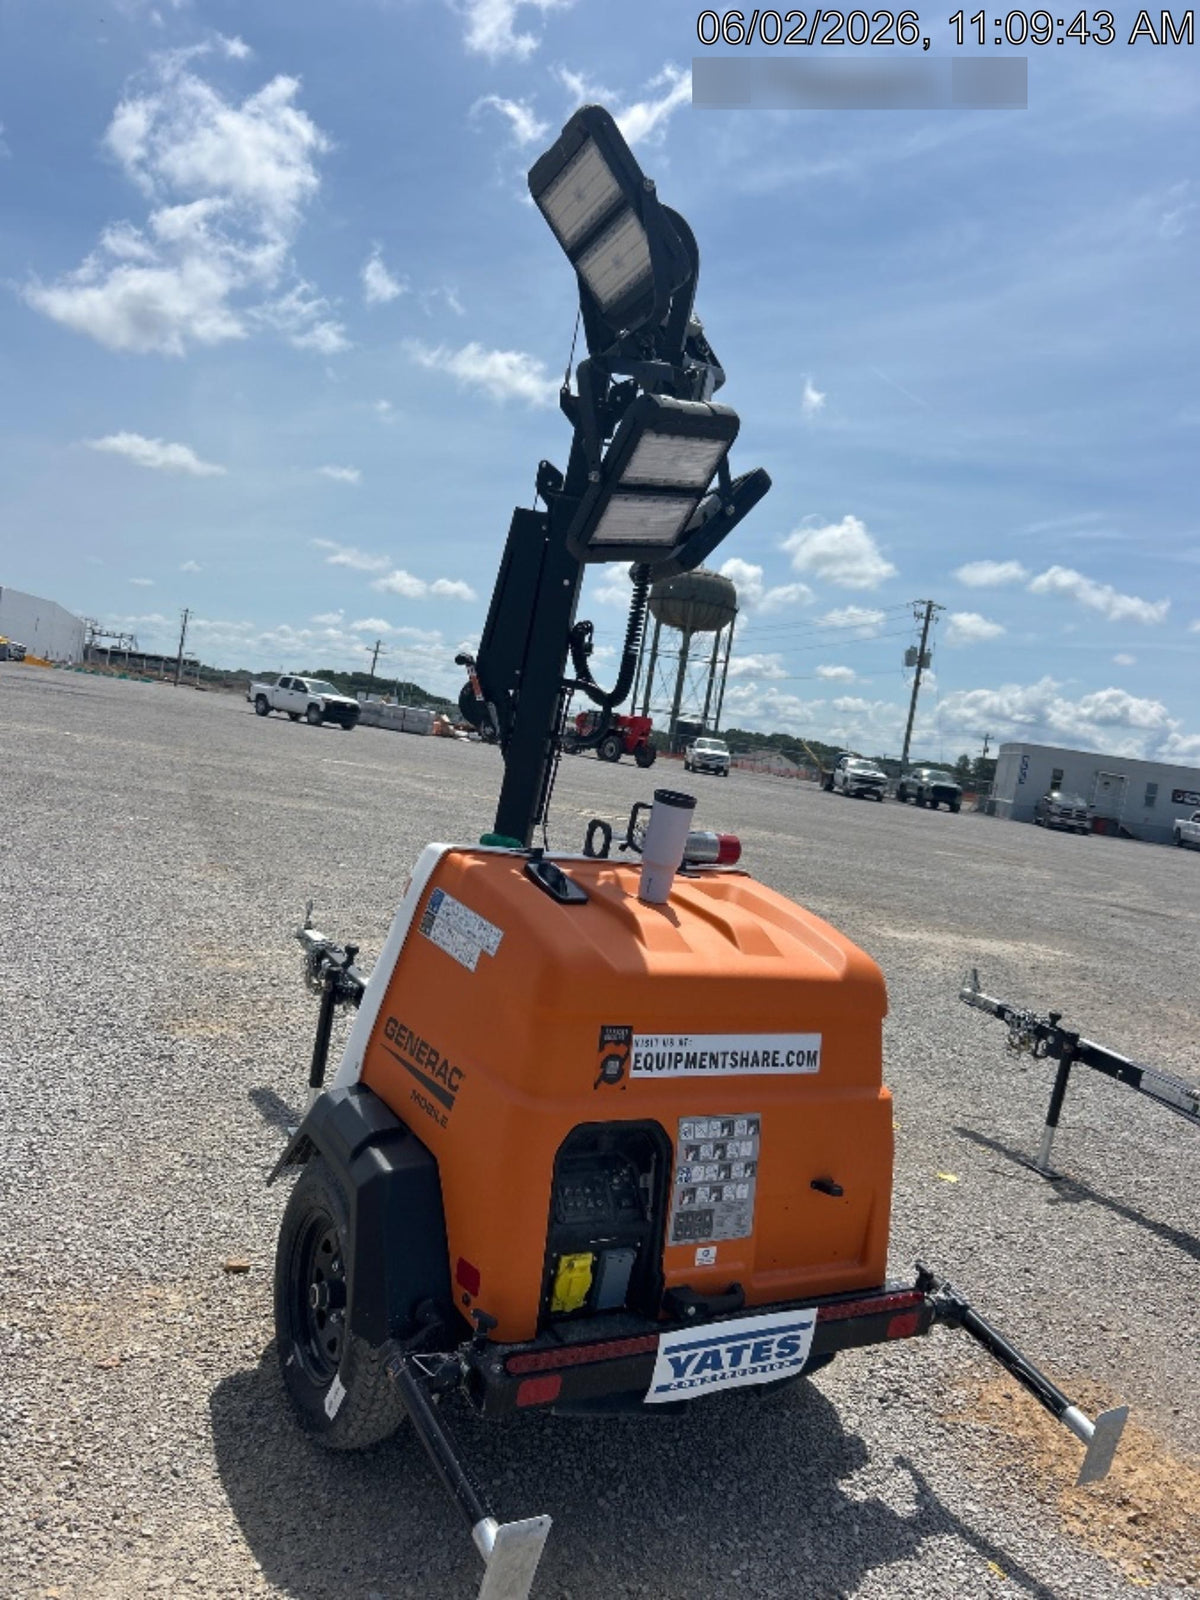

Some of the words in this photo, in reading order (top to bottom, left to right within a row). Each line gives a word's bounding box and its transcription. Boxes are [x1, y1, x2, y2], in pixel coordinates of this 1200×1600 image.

[384, 1016, 463, 1093] GENERAC
[632, 1050, 818, 1072] EQUIPMENTSHARE.COM
[668, 1335, 801, 1379] YATES
